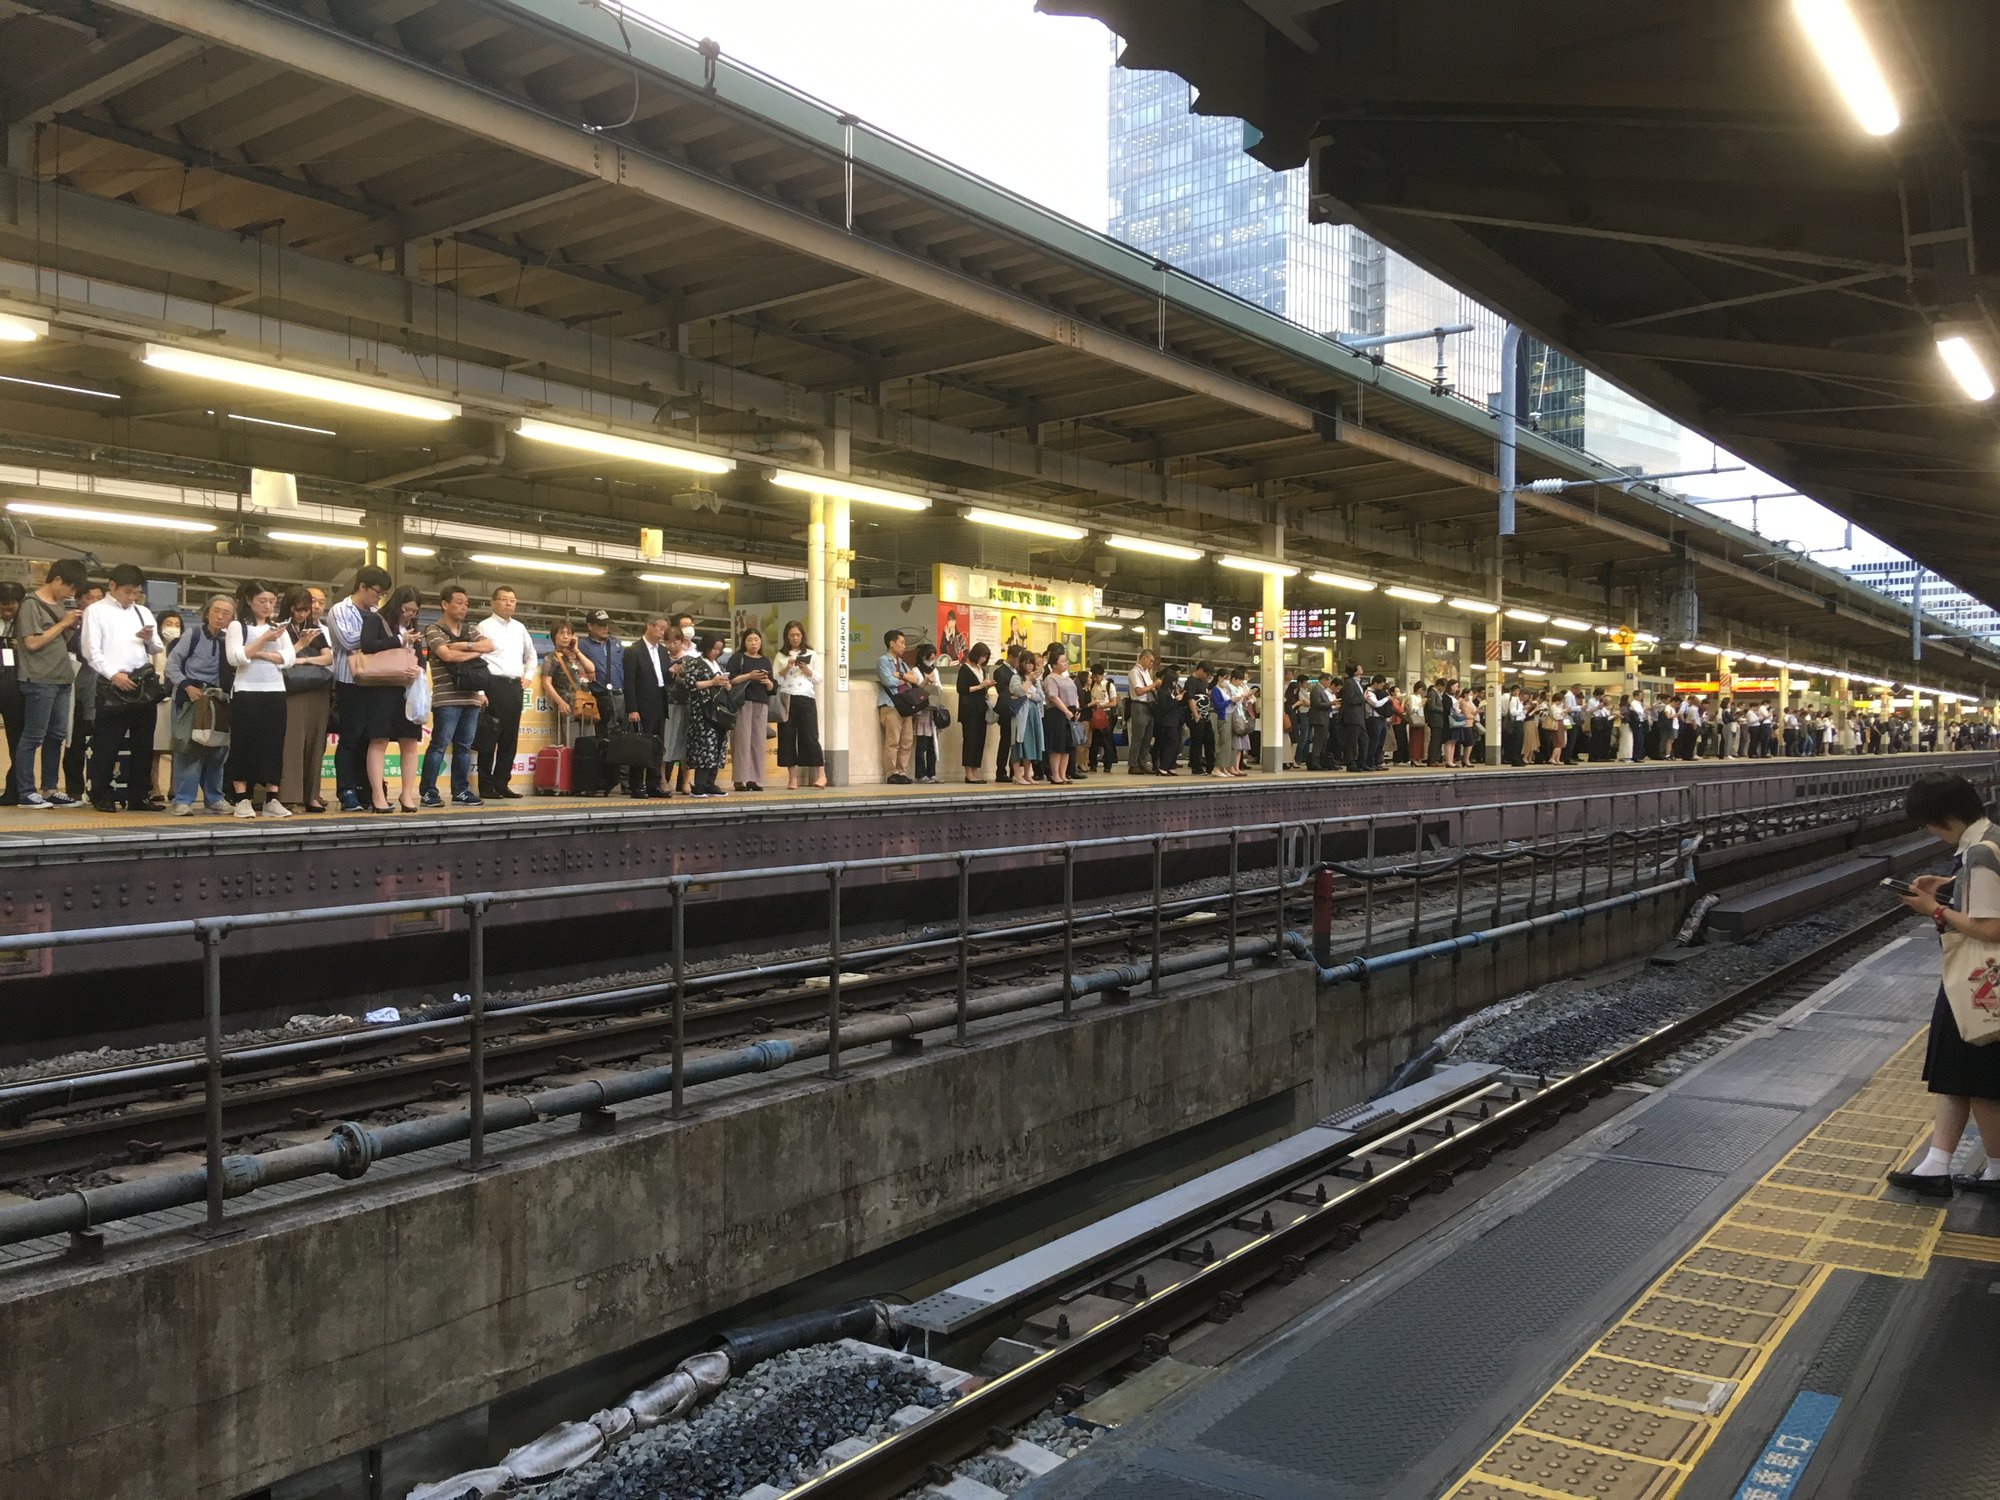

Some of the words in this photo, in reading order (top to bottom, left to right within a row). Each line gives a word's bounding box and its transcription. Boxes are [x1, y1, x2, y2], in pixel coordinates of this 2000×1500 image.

[989, 588, 1032, 605] HONEY'S
[1035, 594, 1057, 608] BAR
[1231, 615, 1242, 632] 8
[1344, 611, 1355, 625] 7
[1517, 640, 1527, 653] 7
